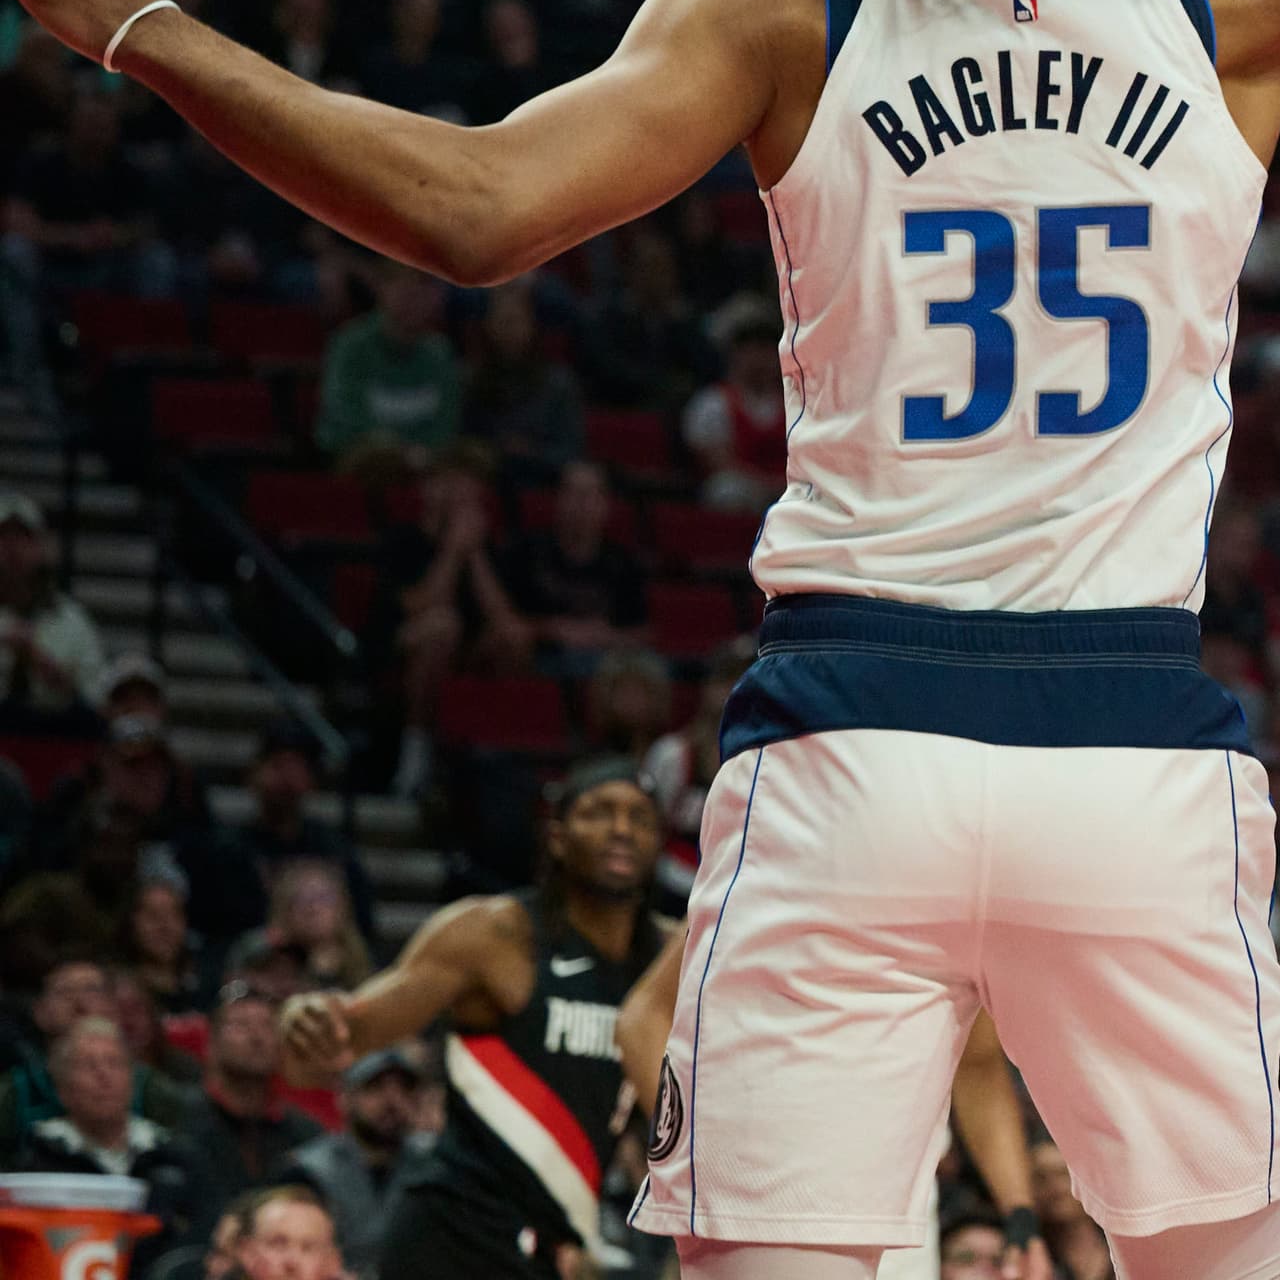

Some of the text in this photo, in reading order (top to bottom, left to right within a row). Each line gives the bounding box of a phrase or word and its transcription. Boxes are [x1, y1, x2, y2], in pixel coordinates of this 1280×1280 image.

[861, 49, 1190, 178] BAGLEY III
[900, 202, 1153, 444] 35
